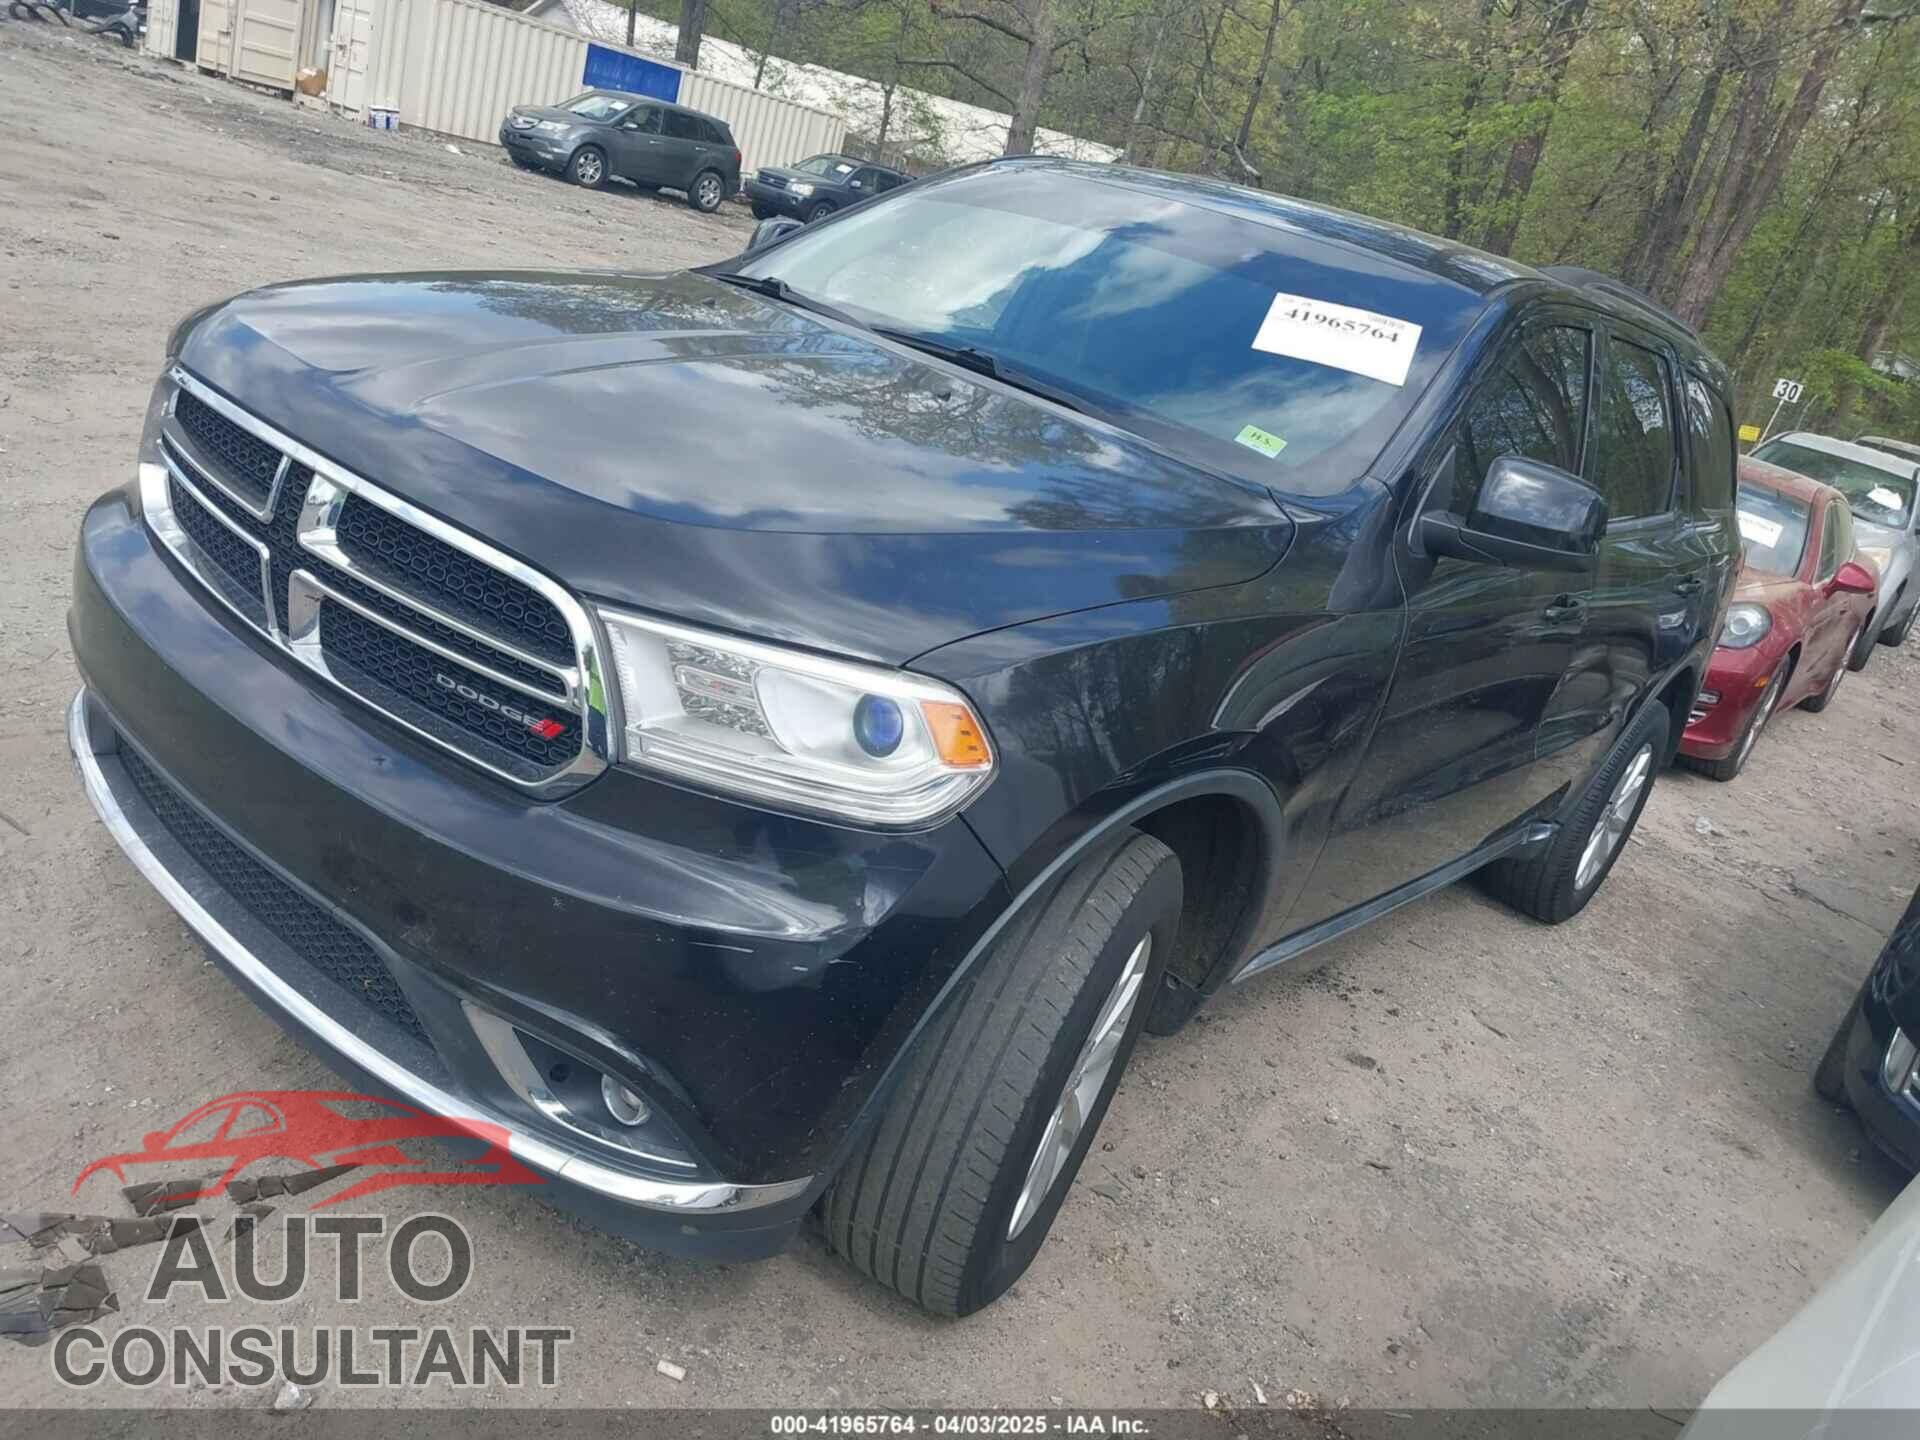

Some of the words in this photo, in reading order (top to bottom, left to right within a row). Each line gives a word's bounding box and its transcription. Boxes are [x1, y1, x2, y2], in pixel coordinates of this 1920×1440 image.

[1283, 308, 1399, 343] 41965764
[1776, 381, 1799, 401] 30
[436, 673, 545, 732] DODGE
